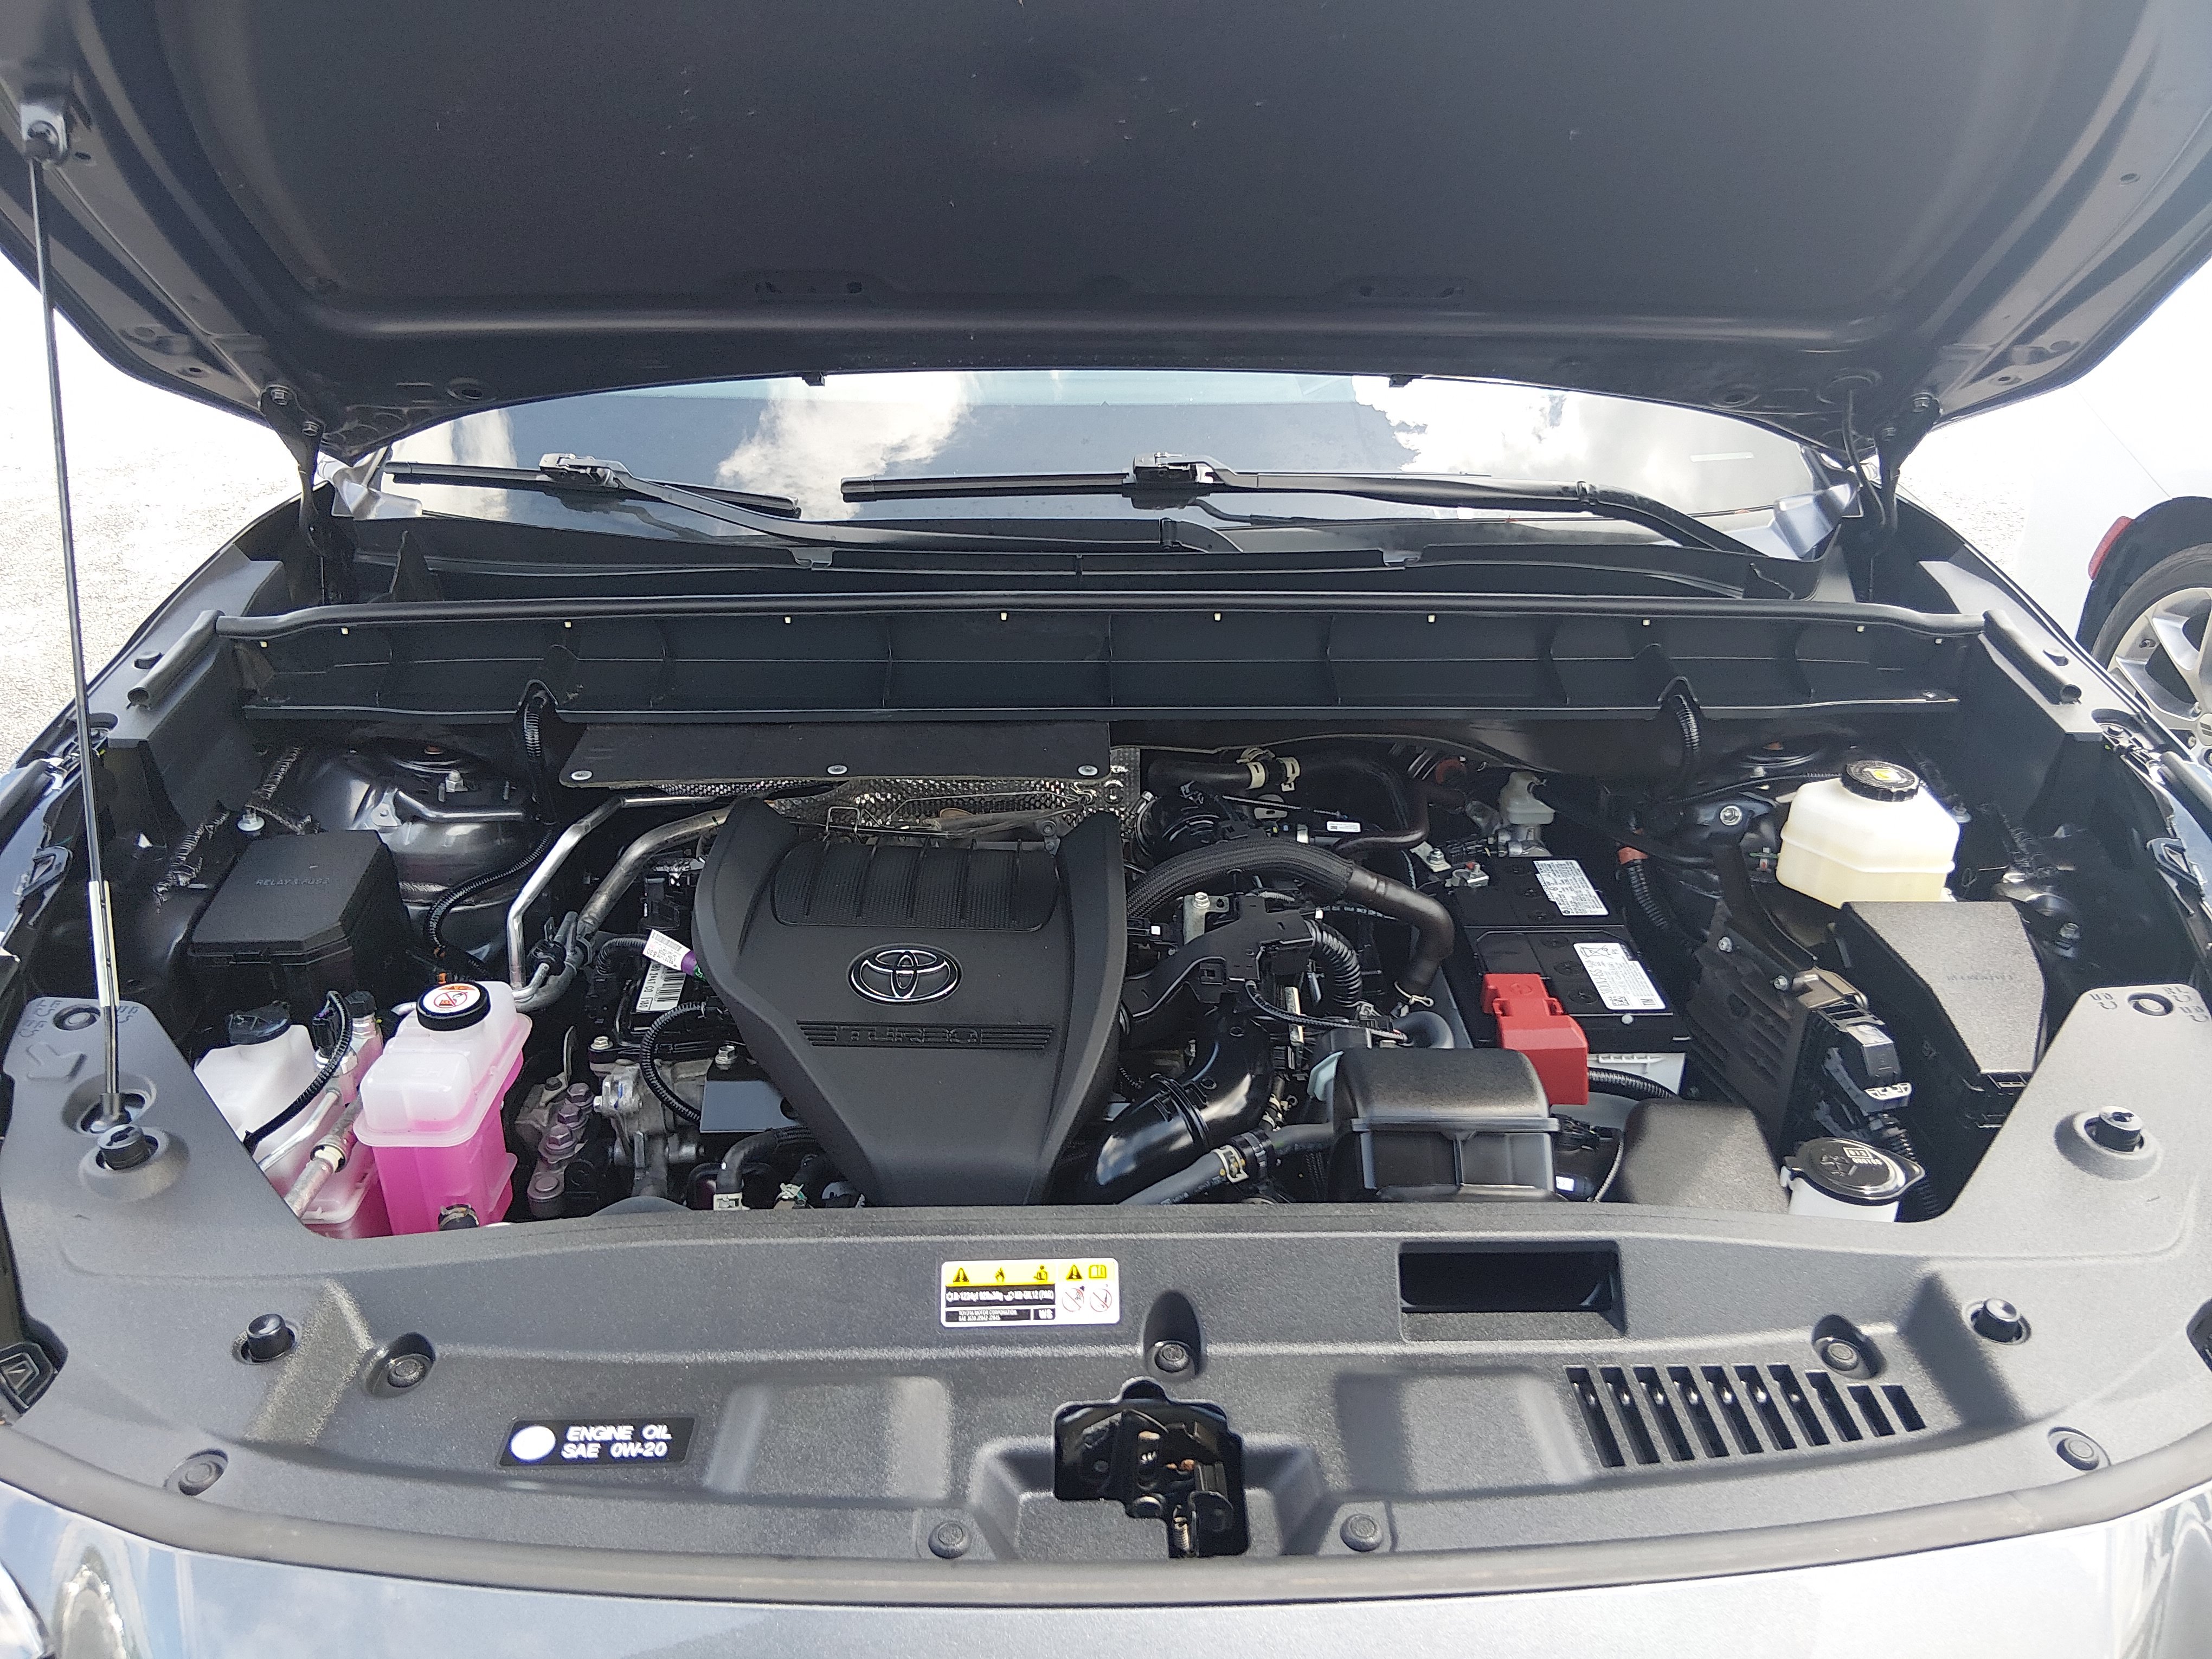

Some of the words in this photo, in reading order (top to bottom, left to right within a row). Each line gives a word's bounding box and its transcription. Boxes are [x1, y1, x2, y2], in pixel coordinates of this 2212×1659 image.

[567, 1425, 634, 1441] ENGINE
[642, 1424, 672, 1440] OIL
[561, 1443, 601, 1459] SAE
[609, 1441, 668, 1458] 0W-20
